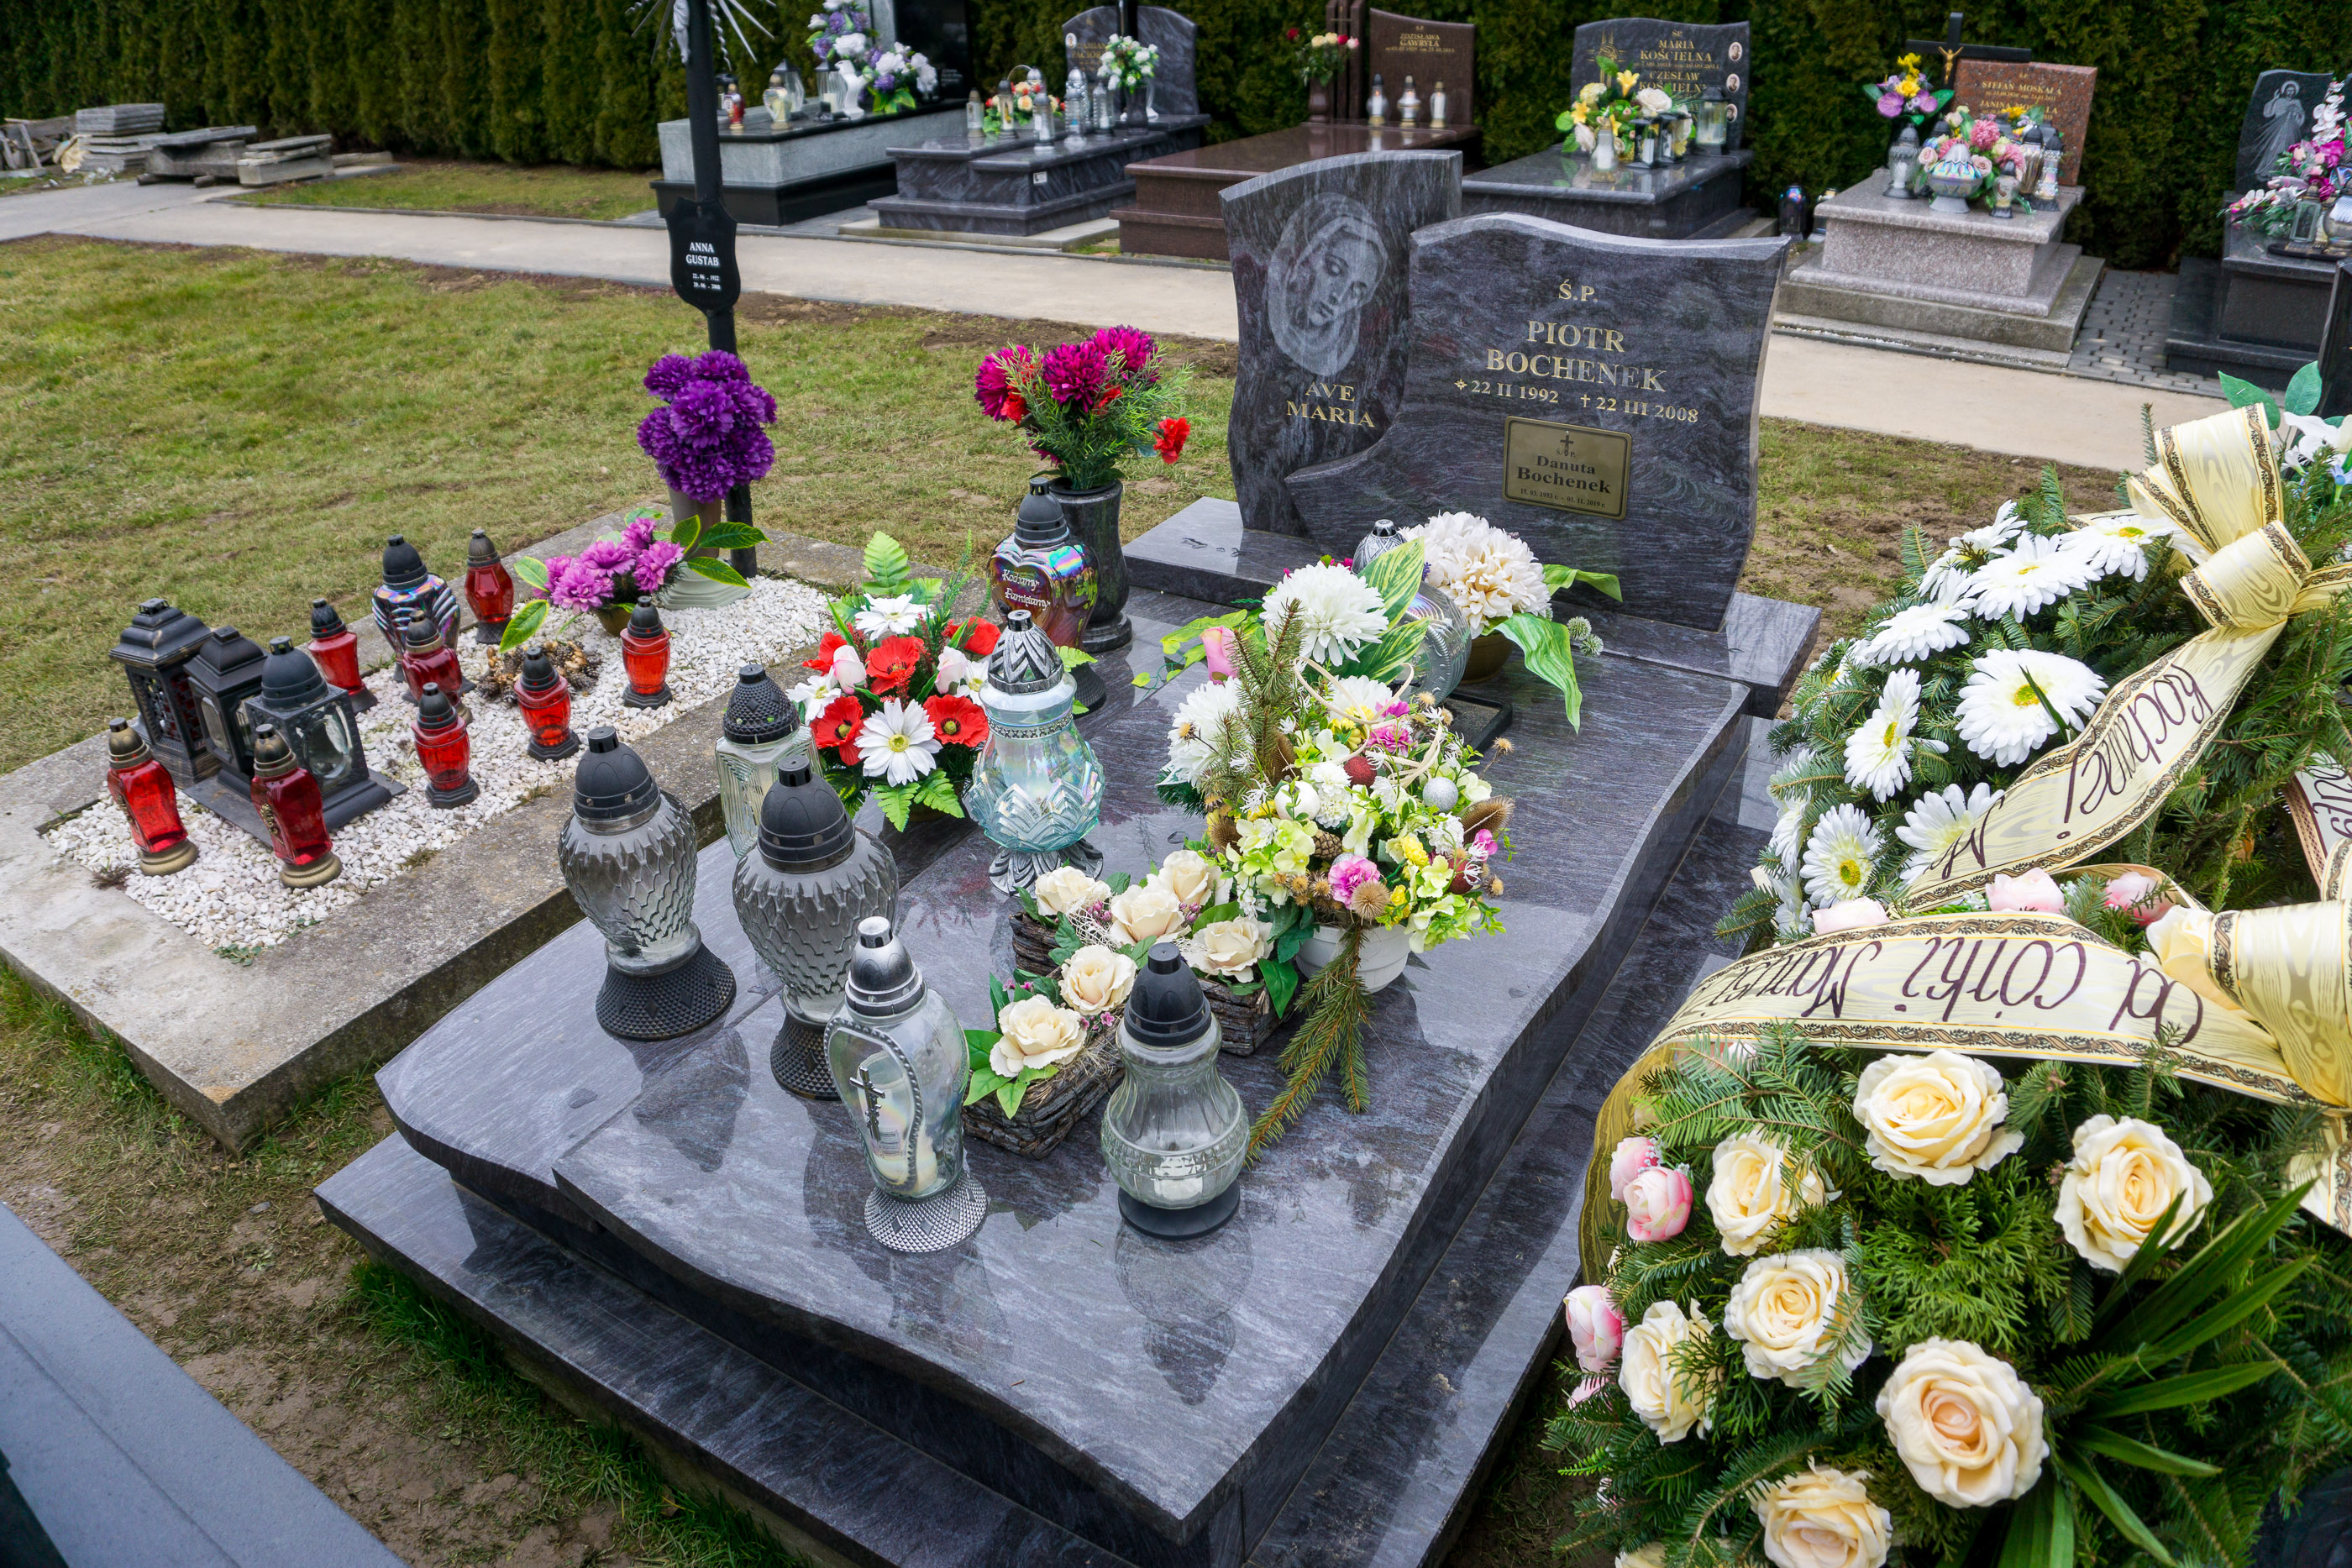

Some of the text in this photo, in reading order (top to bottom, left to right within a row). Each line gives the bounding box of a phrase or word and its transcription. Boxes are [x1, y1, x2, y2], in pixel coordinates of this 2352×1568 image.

[1640, 49, 1712, 61] KOŚCIELNA
[1658, 39, 1695, 50] MARIA
[1982, 81, 2014, 90] STEFAN
[1980, 100, 2011, 108] JANINA
[690, 242, 714, 253] ANNA
[685, 254, 720, 266] GUSTAB
[1558, 279, 1599, 302] Ś.P.
[1526, 320, 1625, 353] PIOTR
[1485, 348, 1667, 392] BOCHENEK
[1305, 381, 1356, 402] AVE
[1471, 380, 1698, 422] 22 II 1992 22 III 2008
[1286, 400, 1375, 427] MARIA
[1536, 455, 1596, 475] Danuta
[1517, 466, 1612, 494] Bochenek
[1002, 569, 1040, 591] Kochamy
[1005, 588, 1051, 611] Pamiętamy
[2057, 663, 2213, 840] Kochanej
[1902, 936, 2087, 1022] córki
[2109, 959, 2203, 1049] Od
